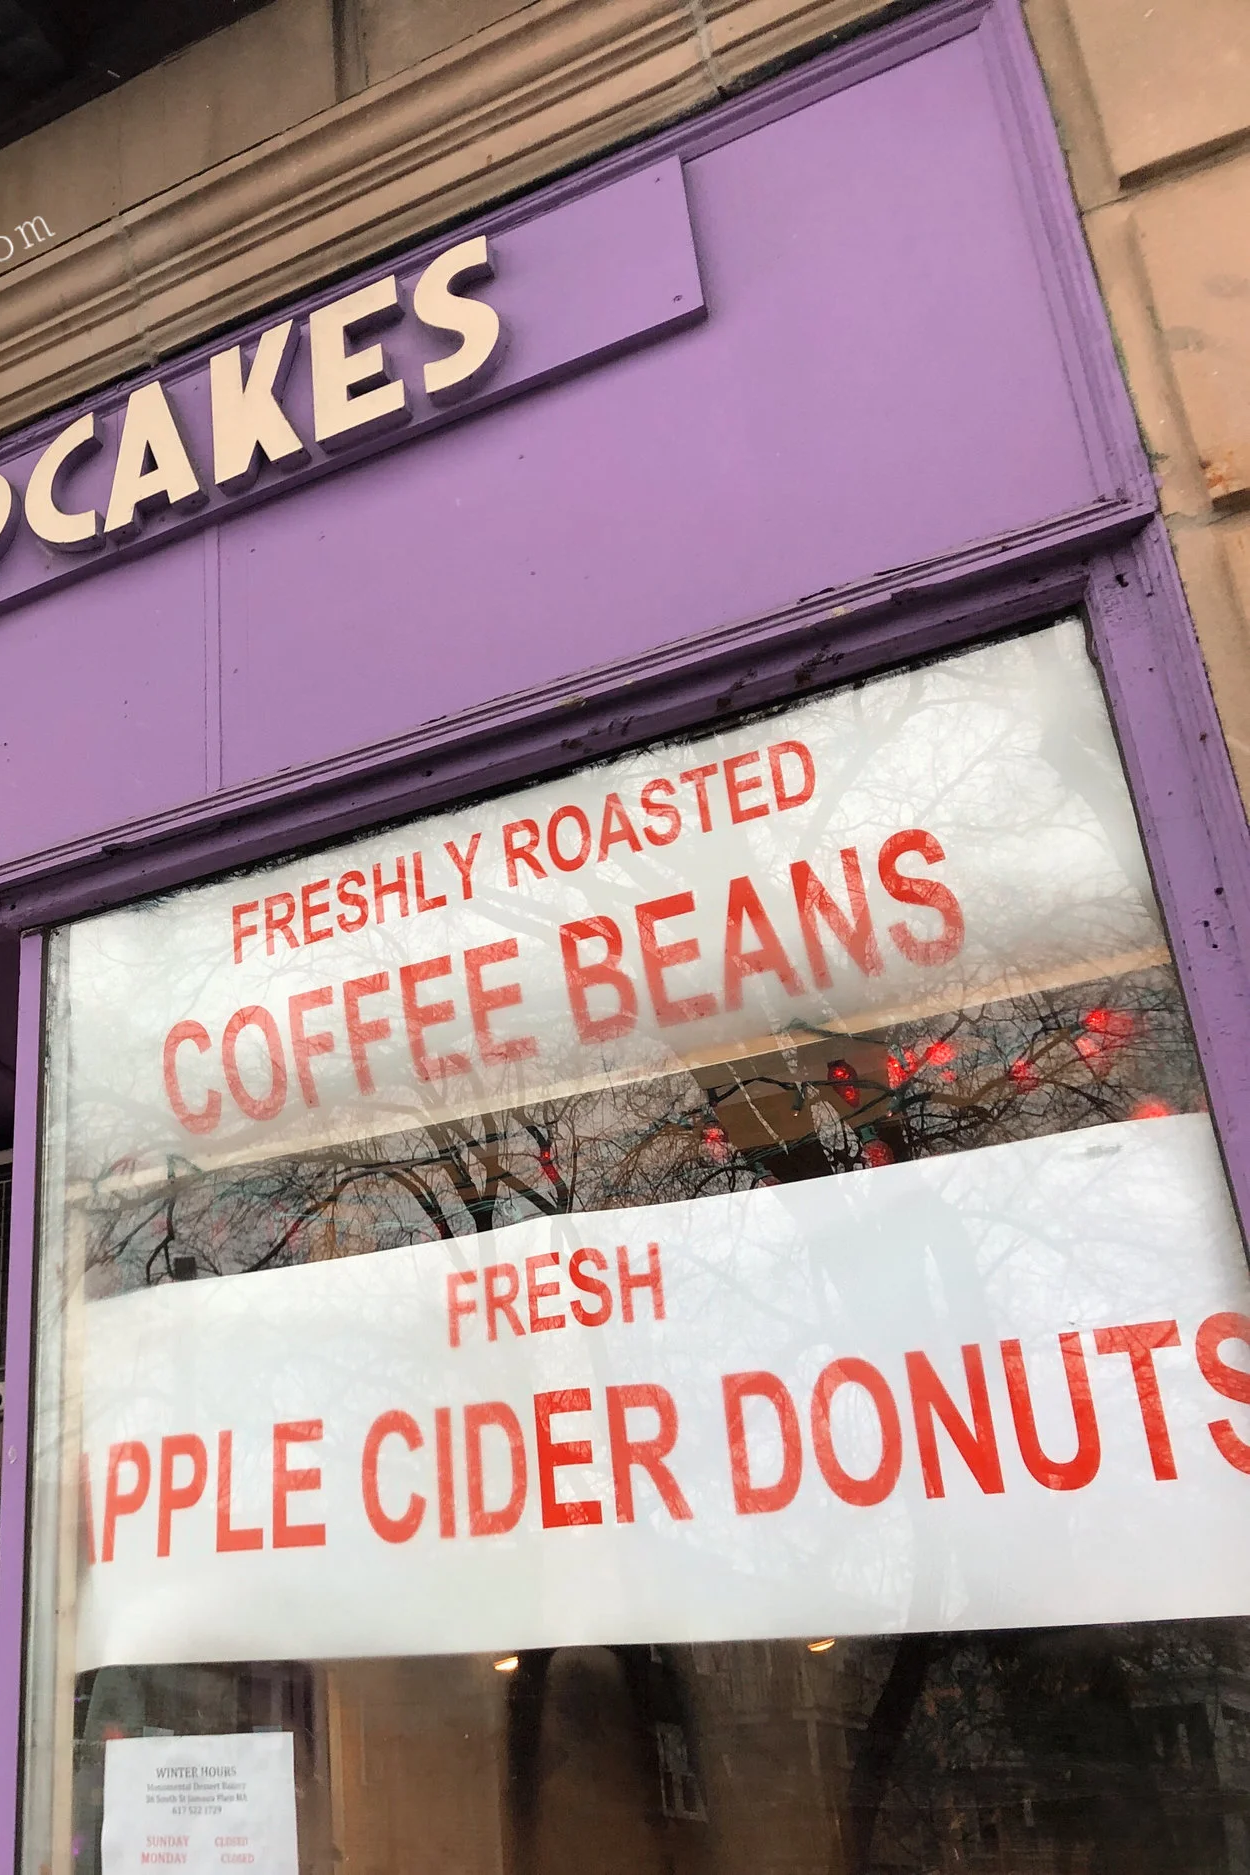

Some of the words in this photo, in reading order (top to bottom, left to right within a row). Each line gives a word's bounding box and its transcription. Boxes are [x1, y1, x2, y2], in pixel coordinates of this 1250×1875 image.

[231, 832, 483, 966] FRESHLY
[502, 739, 818, 888] ROASTED
[162, 937, 539, 1135] COFFEE
[559, 827, 967, 1046] BEANS
[445, 1242, 666, 1348] FRESH
[360, 1382, 695, 1545] CIDER
[156, 1767, 199, 1779] WINTER
[200, 1766, 237, 1778] HOURS
[141, 1851, 188, 1864] MONDAY
[146, 1835, 190, 1848] SUNDAY
